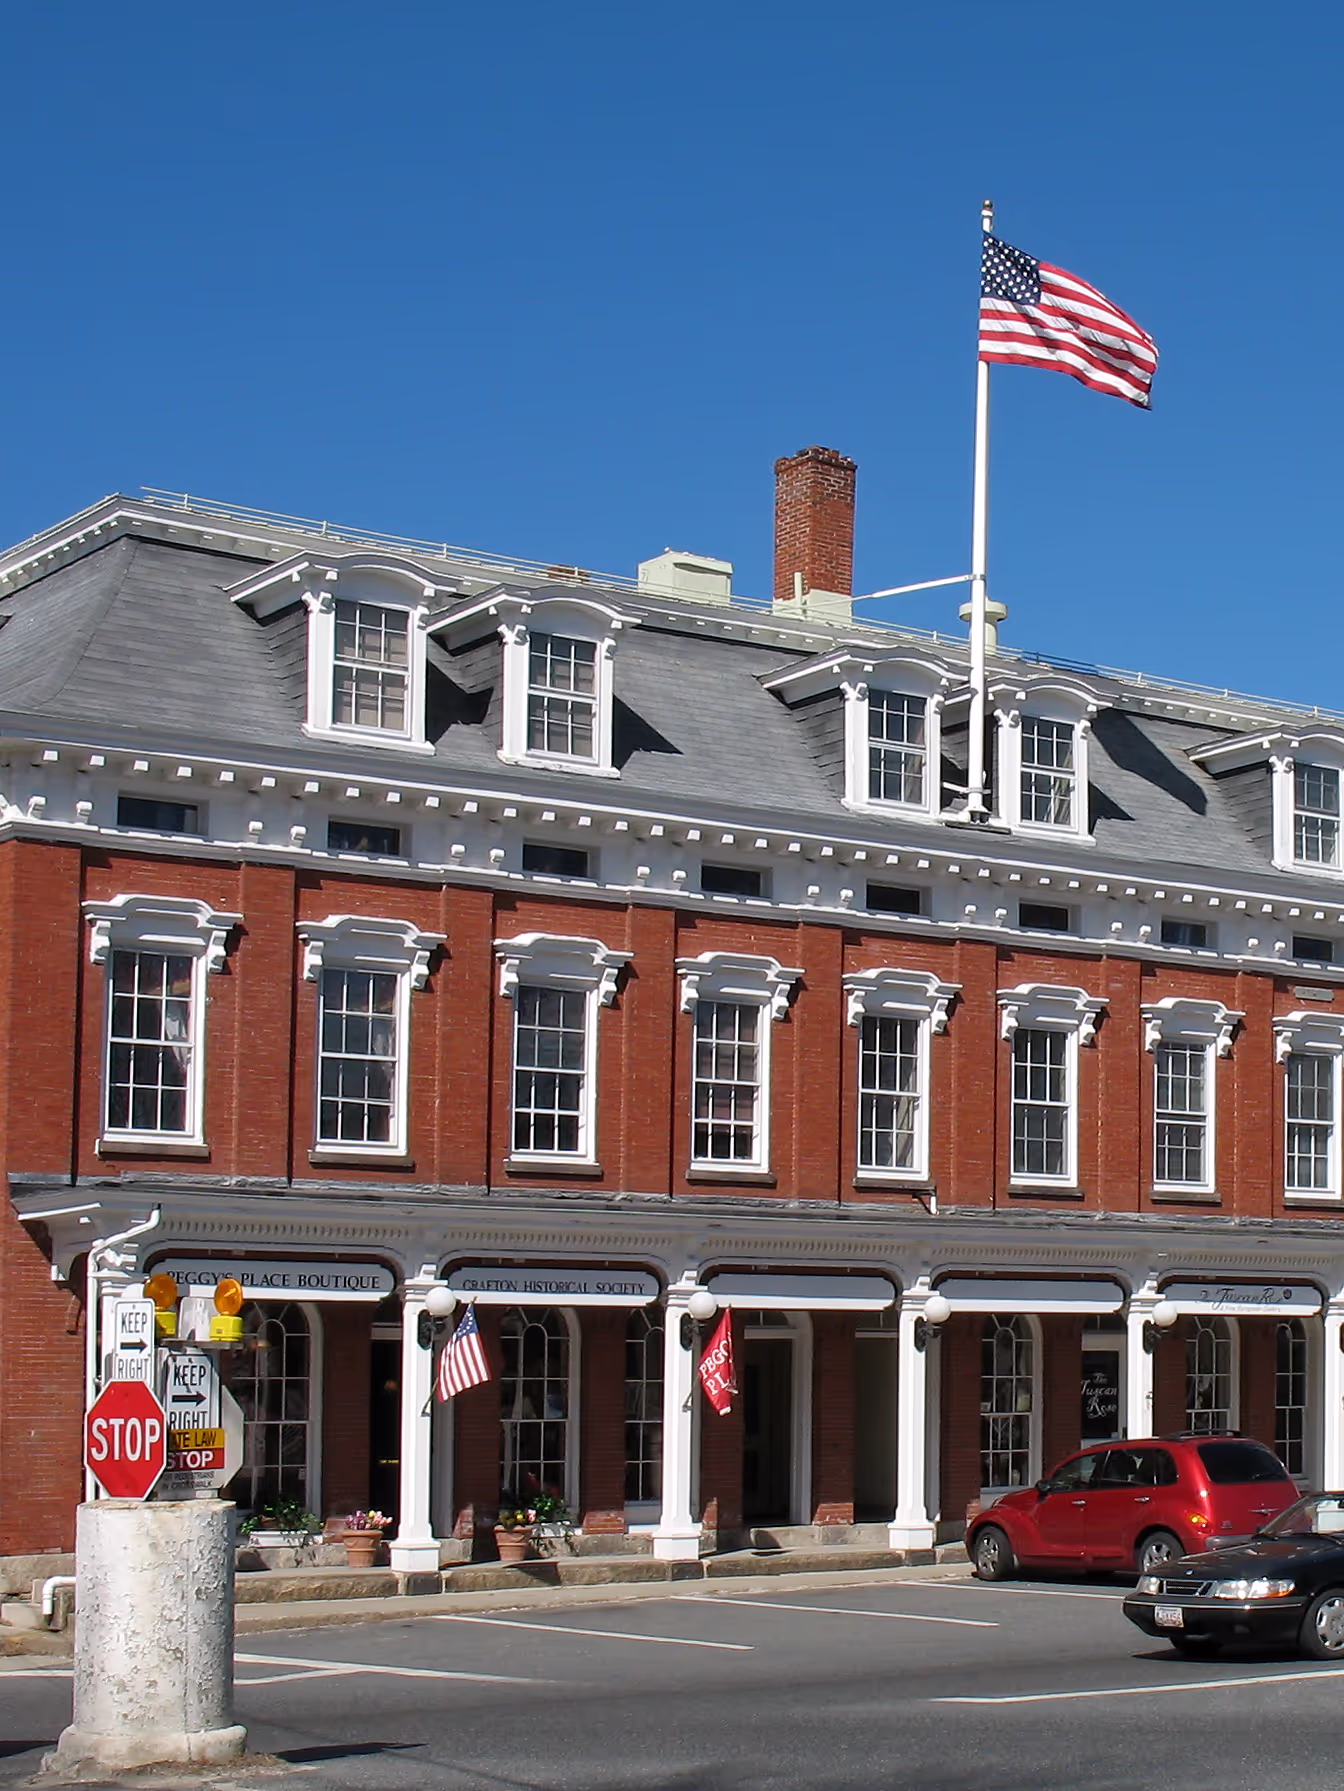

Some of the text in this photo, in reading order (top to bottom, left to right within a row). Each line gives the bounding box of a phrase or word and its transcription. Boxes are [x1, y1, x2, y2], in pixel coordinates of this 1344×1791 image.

[241, 1273, 291, 1287] PLACE
[298, 1274, 380, 1289] BOUTIQUE
[463, 1279, 645, 1294] GRAFTON HISTORICAL SOCIETY
[121, 1312, 148, 1334] KEEP
[118, 1358, 149, 1379] RIGHT
[173, 1365, 207, 1386] KEEP
[170, 1411, 208, 1429] RIGHT
[90, 1418, 161, 1462] STOP
[171, 1431, 217, 1448] ATE LAW
[167, 1450, 214, 1469] STOP
